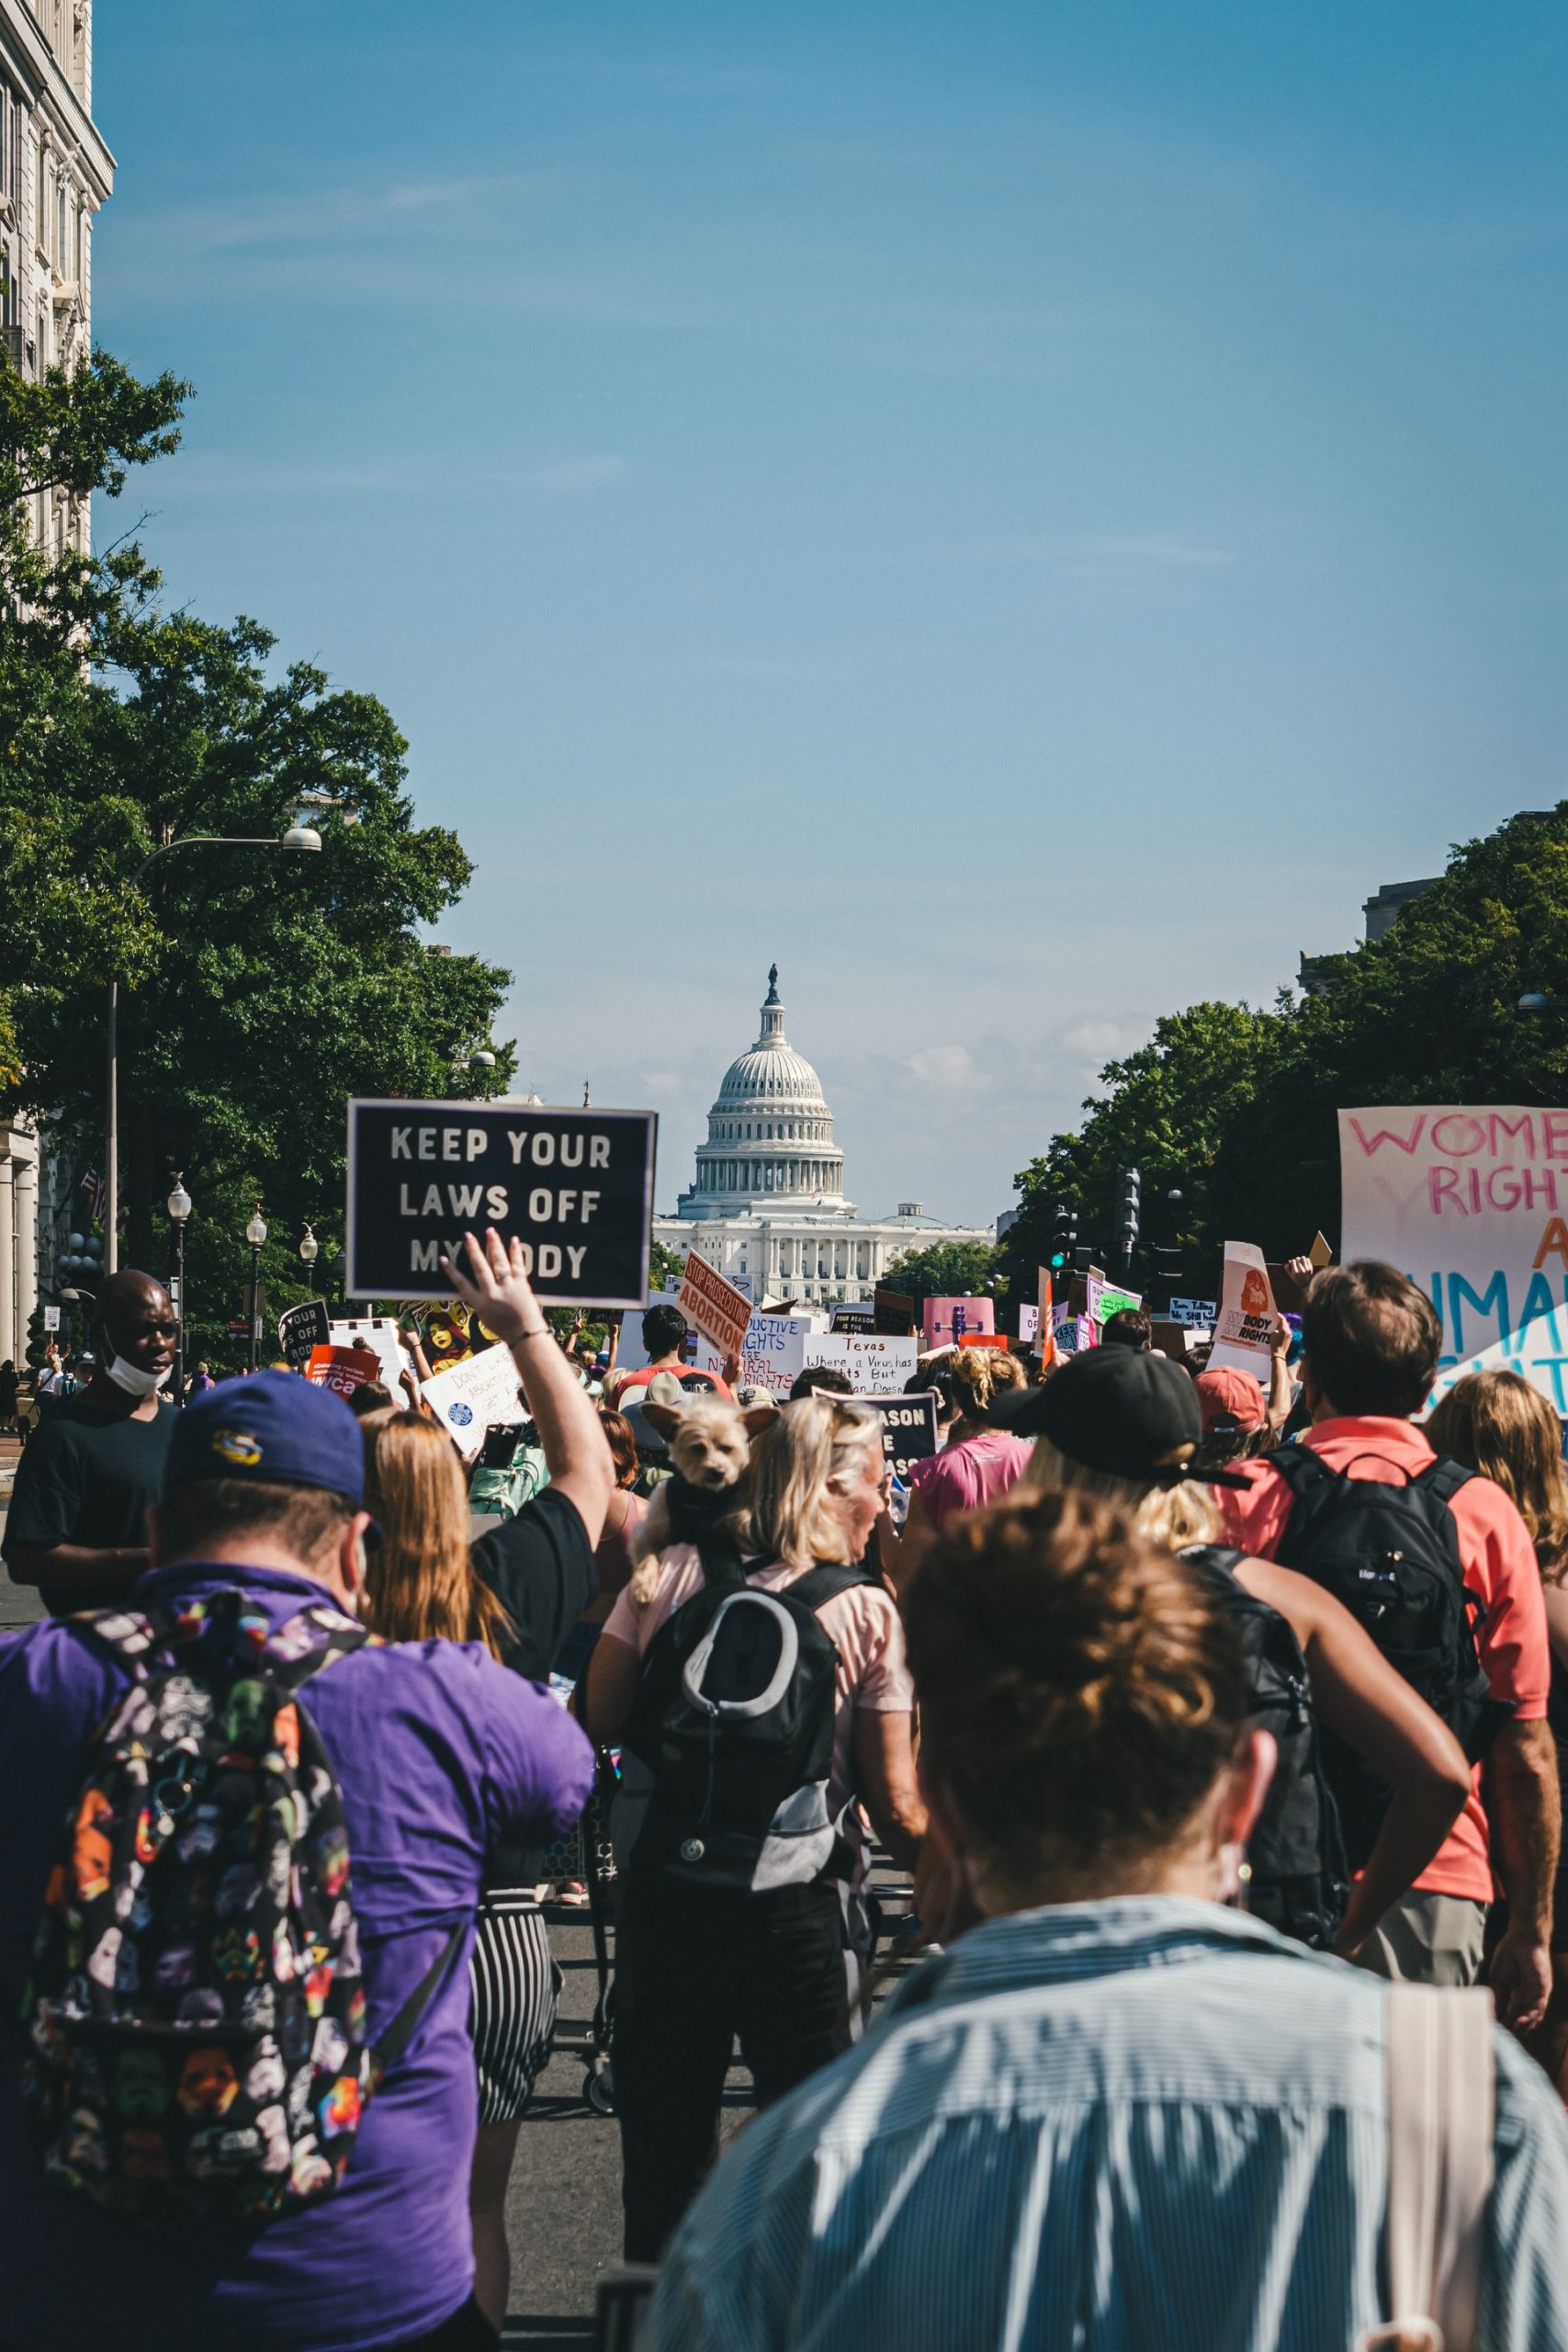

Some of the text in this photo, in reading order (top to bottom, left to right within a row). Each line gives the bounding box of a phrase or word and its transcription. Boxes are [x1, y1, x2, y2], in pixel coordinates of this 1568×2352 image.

[391, 1126, 611, 1169] KEEP YOUR
[1428, 1165, 1568, 1216] RIGH
[400, 1183, 601, 1224] LAWS OFF
[411, 1239, 587, 1279] MY ODY
[686, 1258, 750, 1328] STOP PROSECUTING
[288, 1309, 317, 1327] YOUR
[680, 1284, 743, 1353] ABORTION
[1244, 1315, 1272, 1330] BODY
[298, 1326, 318, 1340] OFF
[1238, 1327, 1271, 1344] RIGHTS
[291, 1342, 317, 1359] BOD
[842, 1337, 886, 1351] Texas
[807, 1354, 847, 1367] Where
[868, 1355, 893, 1367] Virus
[895, 1354, 912, 1367] has
[744, 1374, 794, 1389] RIGHTS
[872, 1369, 897, 1378] But
[876, 1408, 925, 1426] ASON
[884, 1434, 895, 1452] E
